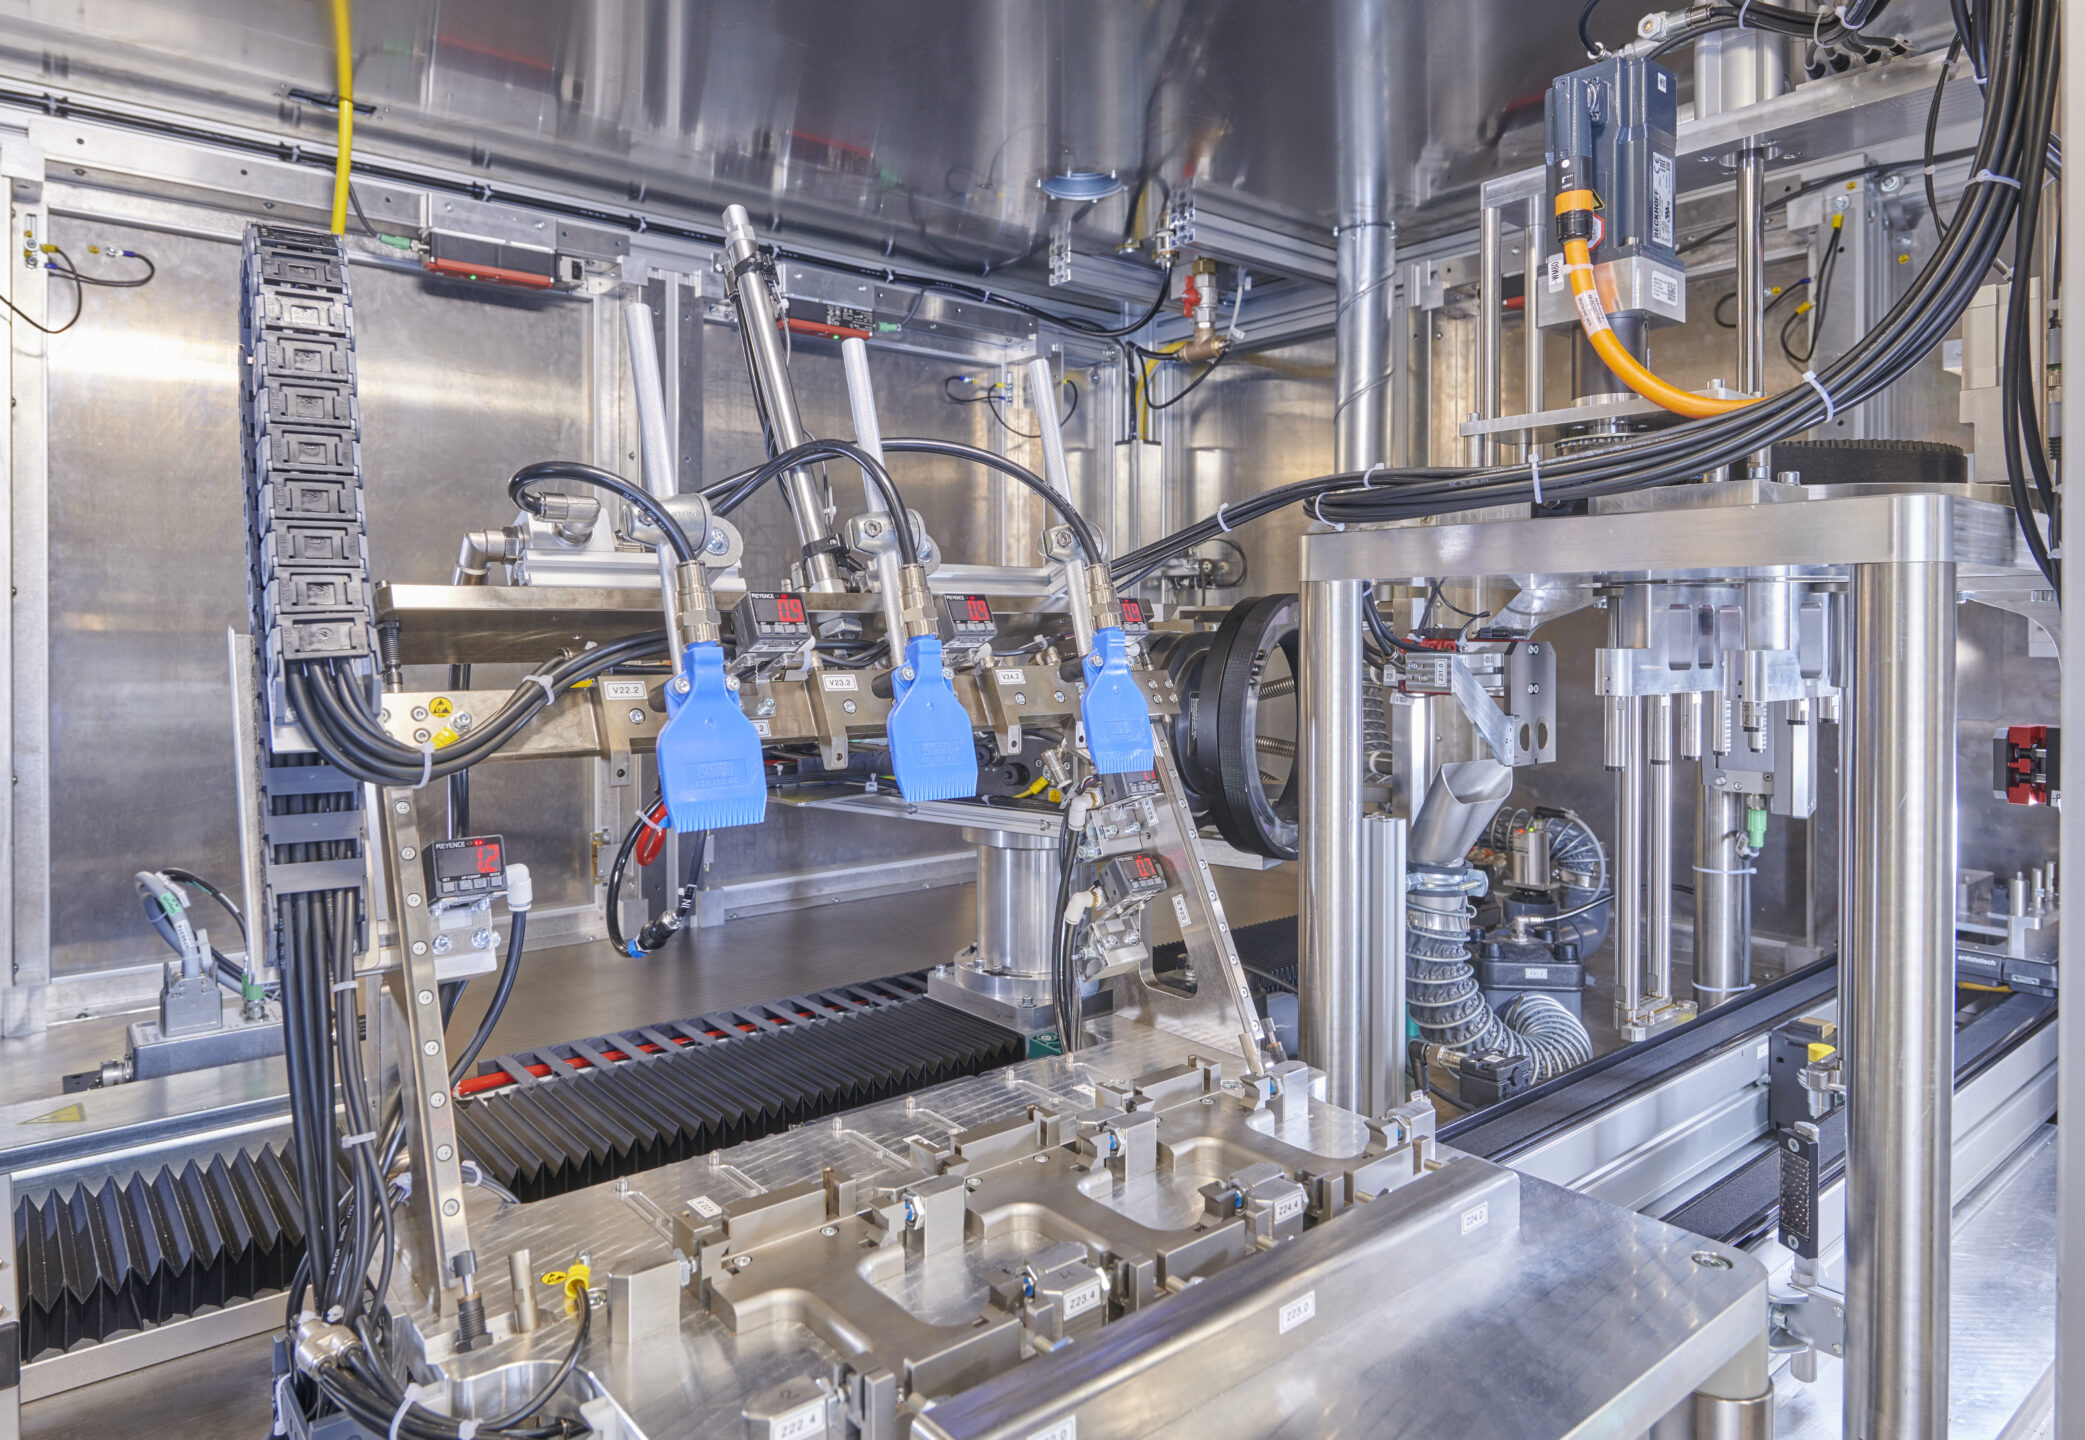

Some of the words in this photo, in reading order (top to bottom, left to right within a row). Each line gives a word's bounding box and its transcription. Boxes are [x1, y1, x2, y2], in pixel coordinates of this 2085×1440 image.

[612, 686, 639, 694] V22.2
[435, 841, 466, 849] KEYENCE
[680, 898, 692, 909] IN
[1957, 955, 1997, 966] antistatisch
[1278, 1199, 1299, 1216] Z24.4
[1069, 1289, 1096, 1310] Z23.4
[780, 1413, 816, 1438] Z22.4
